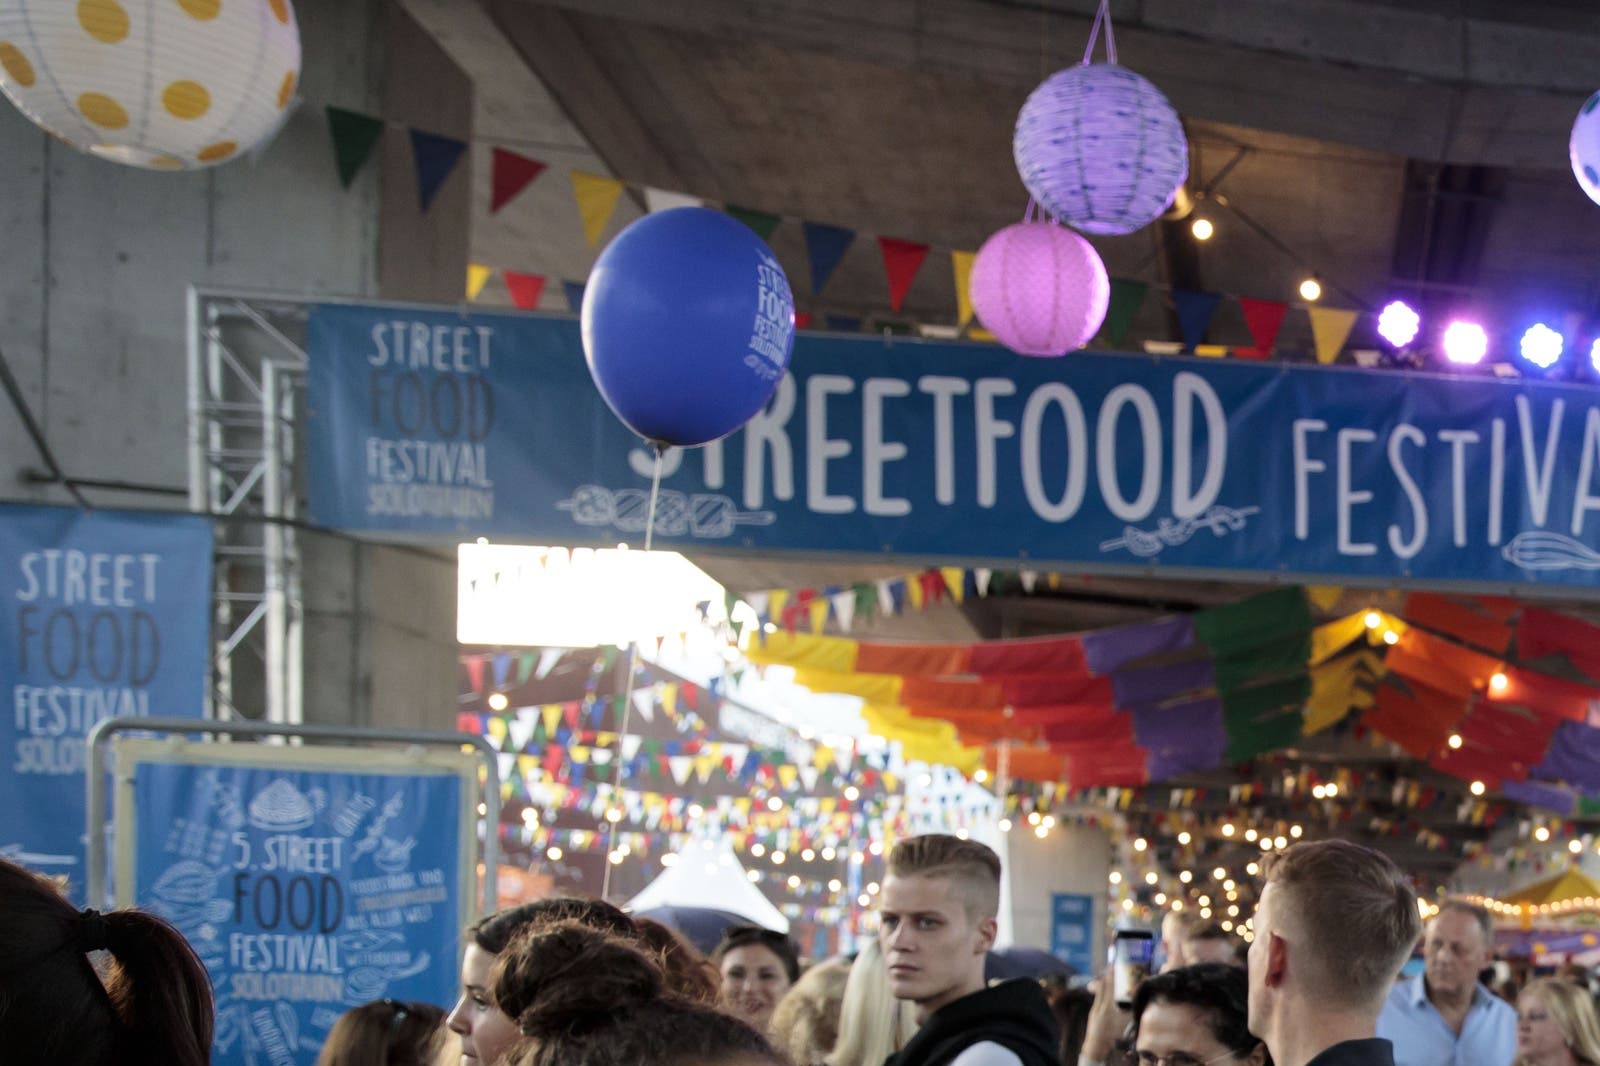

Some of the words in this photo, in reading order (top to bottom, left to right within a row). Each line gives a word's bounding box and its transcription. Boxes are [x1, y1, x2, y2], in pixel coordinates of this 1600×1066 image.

[367, 320, 495, 373] STREET
[368, 368, 496, 443] FOOD
[366, 436, 495, 488] FESTIVAL
[16, 548, 162, 607] STREET
[17, 604, 161, 688] FOOD
[231, 831, 258, 871] 5.
[263, 834, 344, 874] STREET
[233, 872, 344, 935] FOOD
[230, 932, 344, 974] FESTIVAL
